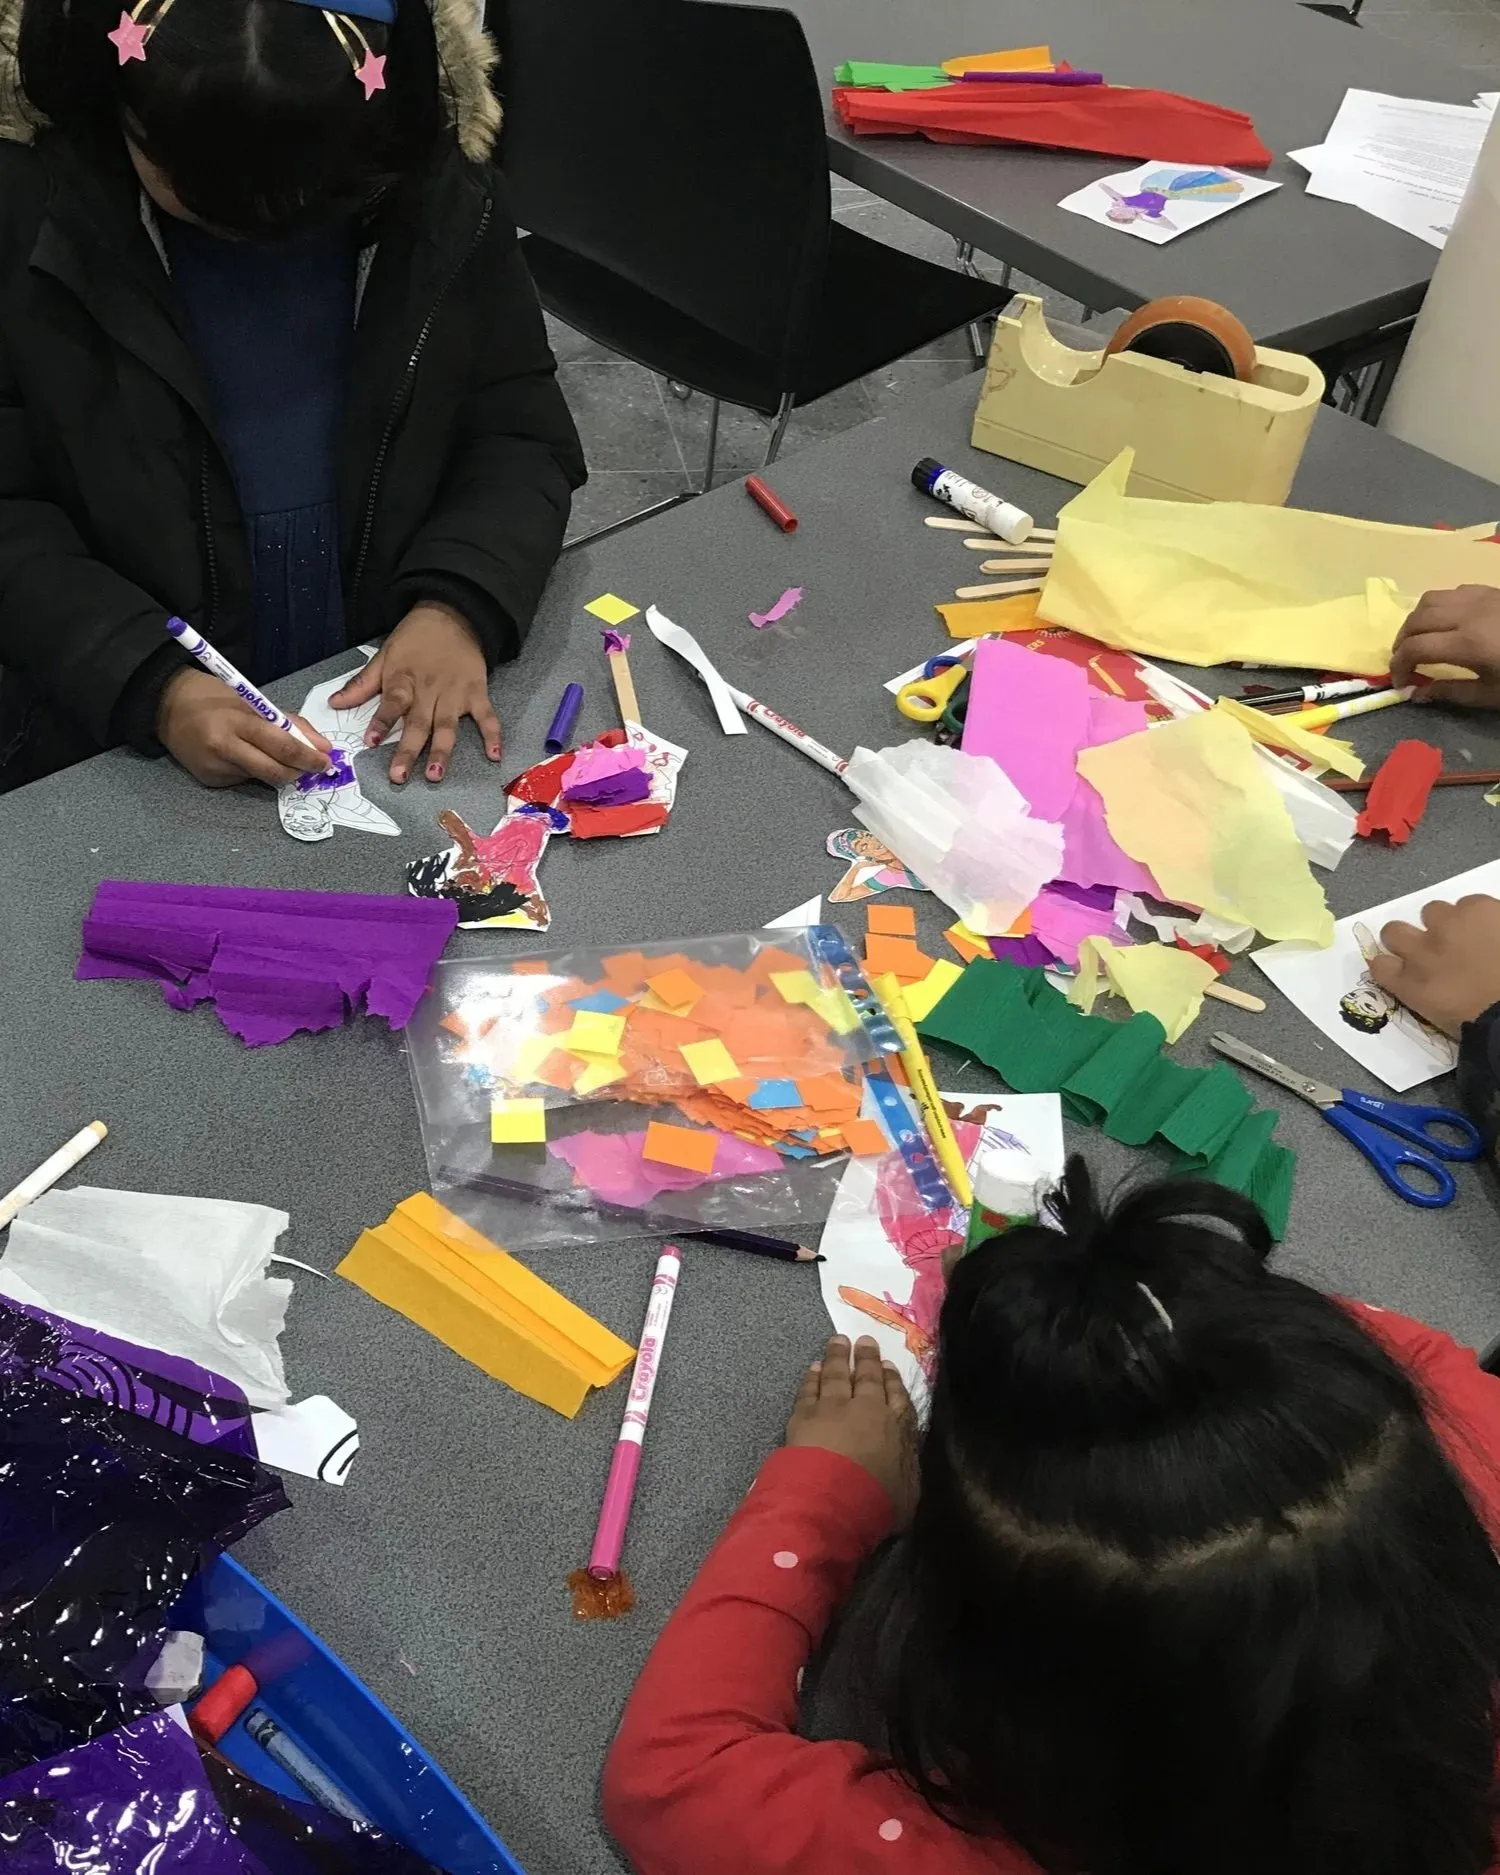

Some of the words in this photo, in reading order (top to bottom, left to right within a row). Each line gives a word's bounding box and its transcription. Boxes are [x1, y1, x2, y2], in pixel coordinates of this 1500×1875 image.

[236, 683, 278, 723] Crayola
[764, 707, 805, 737] Crayola
[632, 1337, 657, 1401] Crayola
